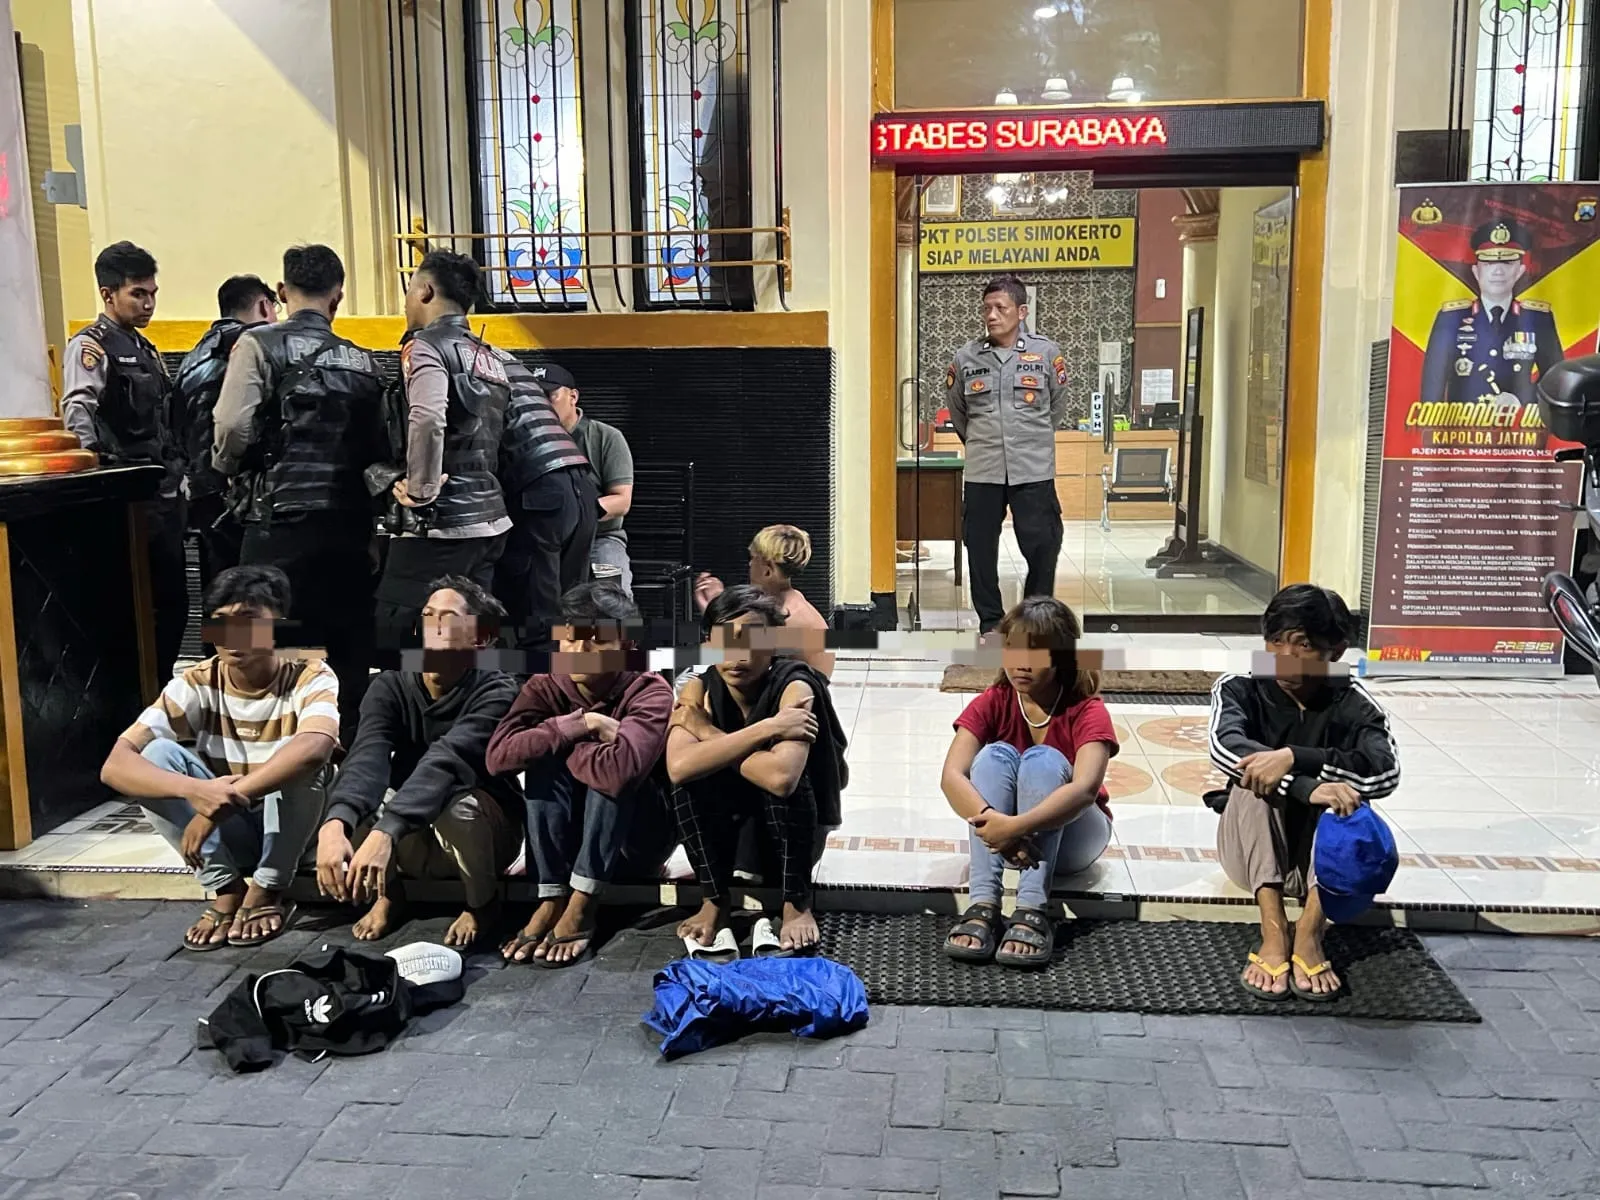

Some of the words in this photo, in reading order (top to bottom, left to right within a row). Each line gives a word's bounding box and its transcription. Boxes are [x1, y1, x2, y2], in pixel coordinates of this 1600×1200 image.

[995, 116, 1167, 149] SURABAYA
[955, 227, 1020, 243] POLSEK
[1024, 224, 1121, 241] SIMOKERTO
[927, 250, 963, 265] SIAP
[969, 247, 1050, 264] MELAYANI
[1055, 246, 1100, 262] ANDA
[290, 336, 372, 373] POLISI
[1016, 364, 1044, 372] POLRI
[1093, 394, 1101, 428] PUSH
[1406, 402, 1519, 427] COMMANDER
[1432, 430, 1492, 445] KAPOLDA
[1497, 431, 1537, 446] JATIM
[1411, 448, 1436, 456] IRJEN
[1469, 448, 1491, 456] IMAM
[1494, 641, 1554, 651] PRESISI
